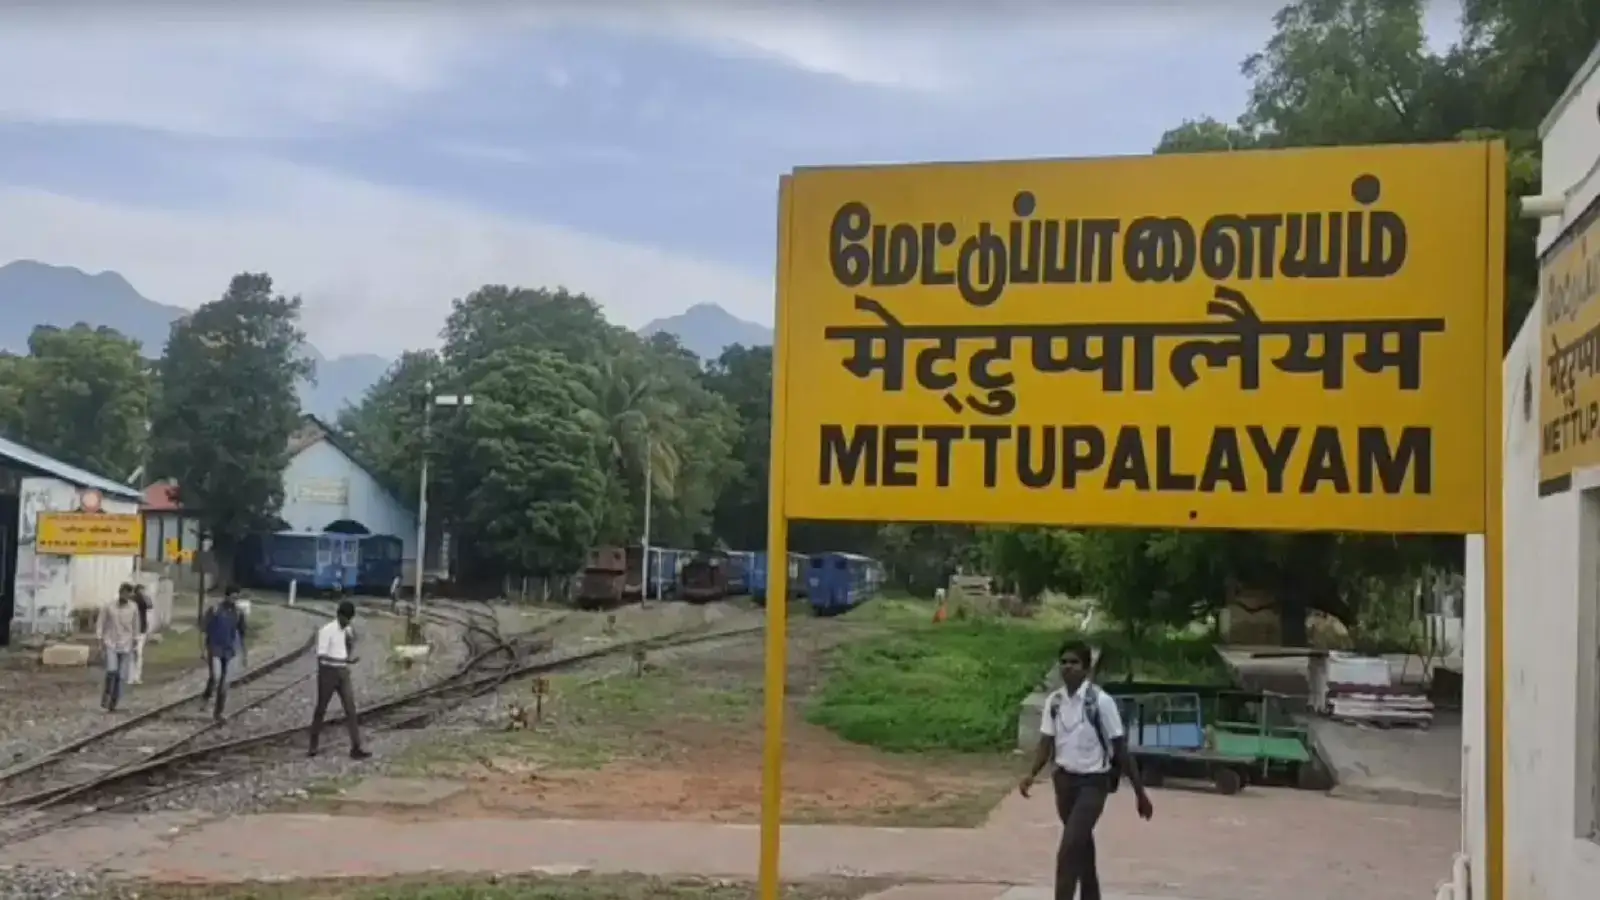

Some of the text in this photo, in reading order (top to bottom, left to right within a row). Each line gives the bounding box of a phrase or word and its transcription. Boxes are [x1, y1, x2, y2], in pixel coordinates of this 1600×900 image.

[829, 174, 1407, 307] மேட்டுப்பாளையம்
[819, 425, 1432, 496] METTUPALAYAM
[1543, 400, 1600, 456] METTUP
